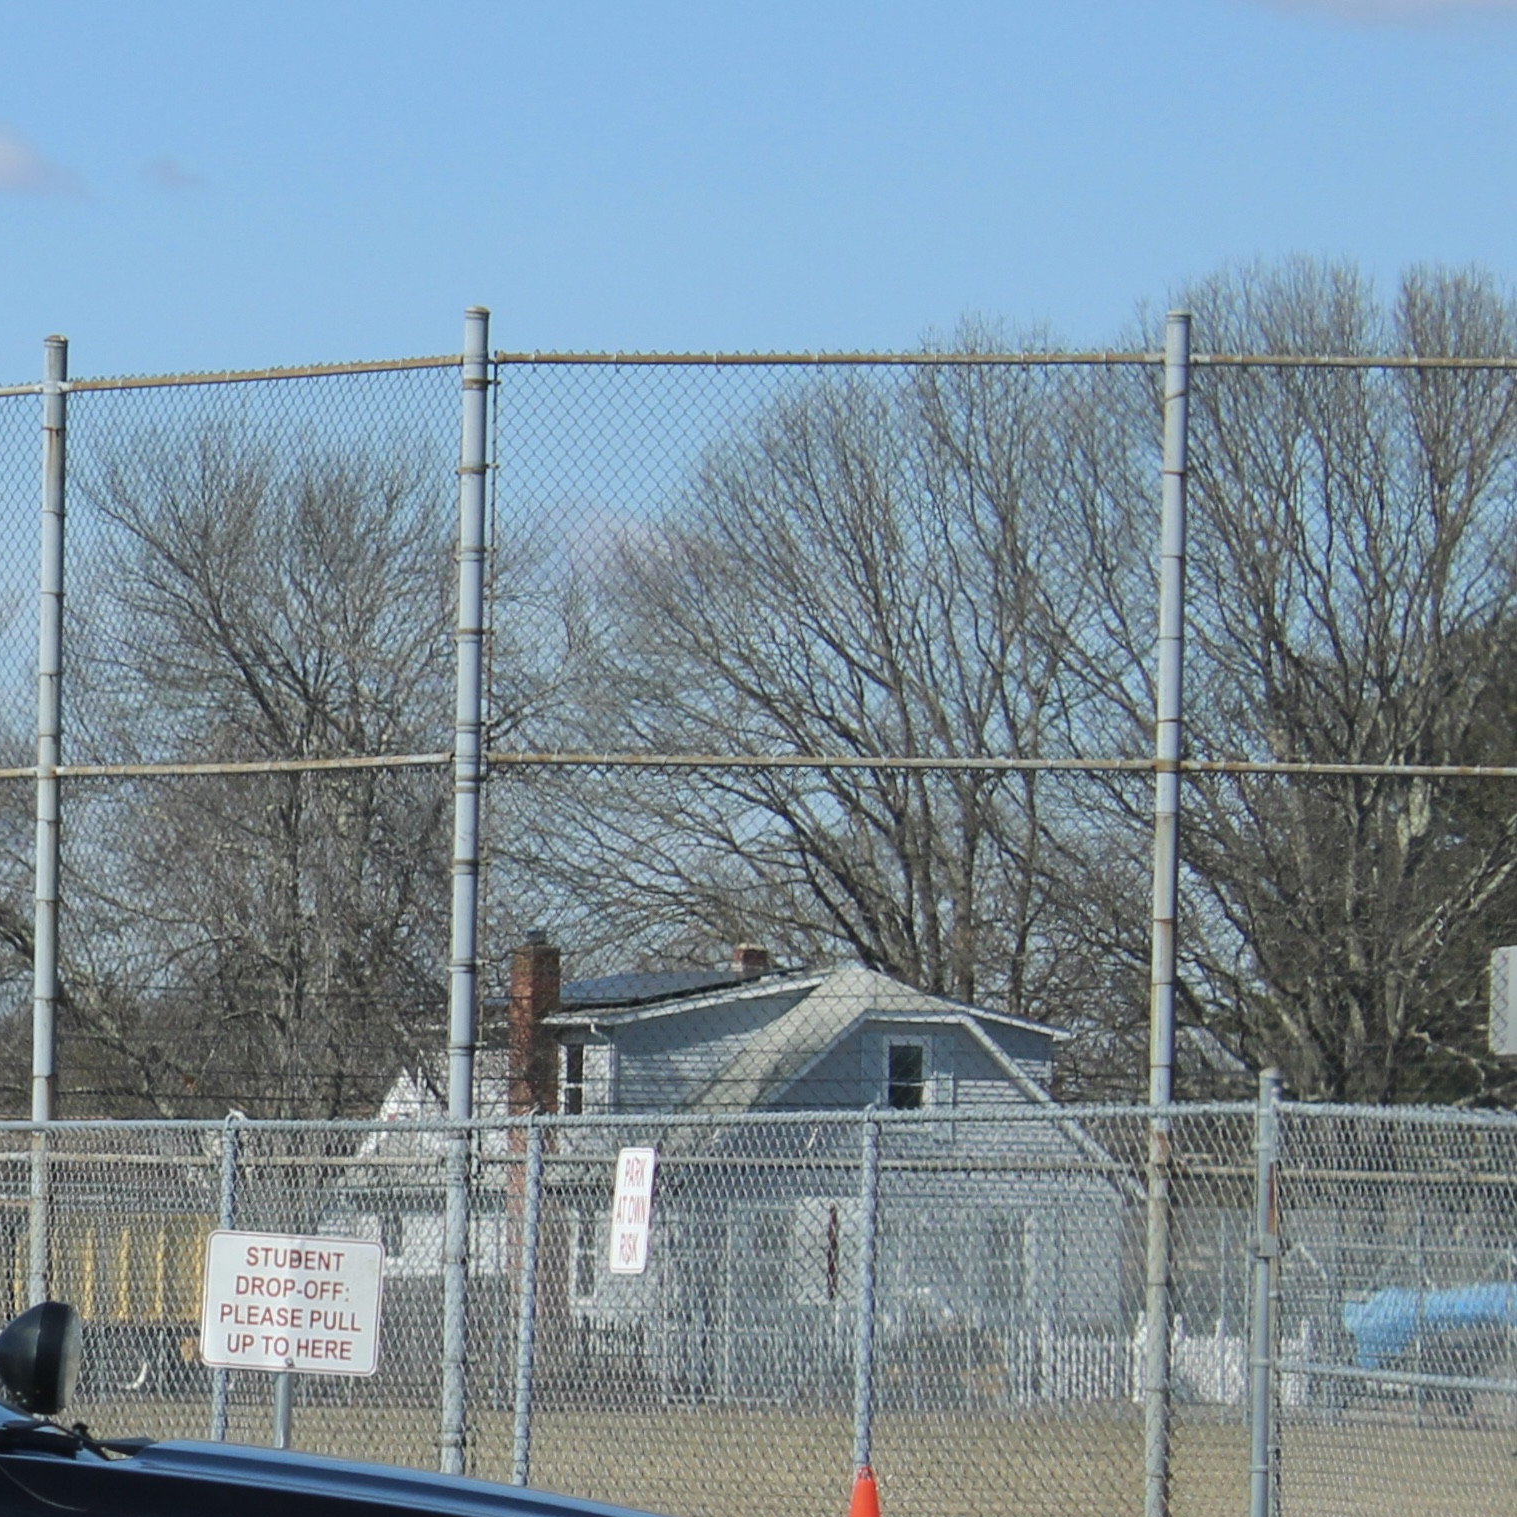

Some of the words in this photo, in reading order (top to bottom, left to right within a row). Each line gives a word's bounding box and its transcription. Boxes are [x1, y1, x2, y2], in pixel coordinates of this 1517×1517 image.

[624, 1157, 647, 1187] PARK
[615, 1196, 627, 1224] AT
[628, 1196, 647, 1224] OWN
[246, 1246, 345, 1272] STUDENT
[619, 1233, 638, 1262] RISK
[235, 1275, 350, 1302] DROP-OFF:
[220, 1304, 304, 1329] PLEASE
[309, 1310, 362, 1332] PULL
[227, 1333, 255, 1354] UP
[261, 1336, 290, 1357] TO
[296, 1338, 353, 1360] HERE
